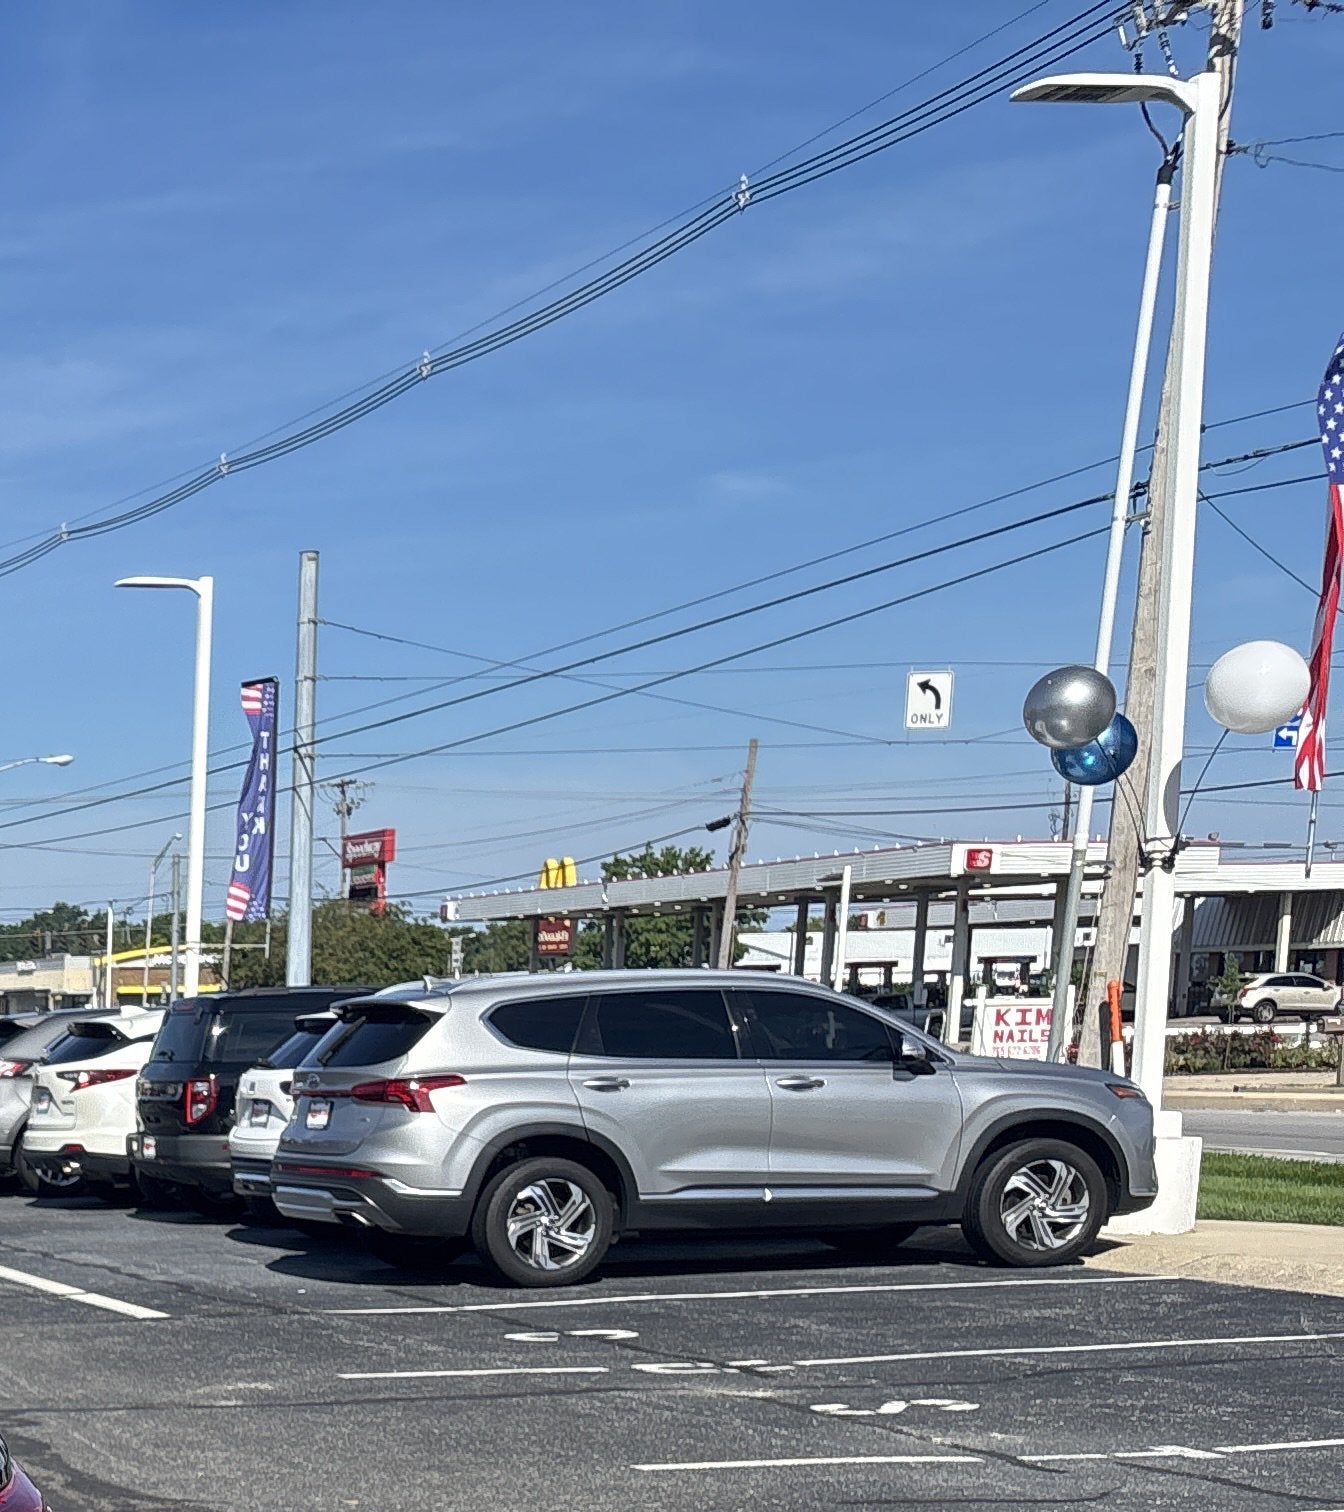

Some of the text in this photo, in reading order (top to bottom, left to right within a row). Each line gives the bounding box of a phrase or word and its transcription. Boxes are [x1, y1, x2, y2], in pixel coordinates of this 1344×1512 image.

[910, 713, 944, 725] ONLY
[994, 1007, 1054, 1027] KIM
[993, 1029, 1051, 1043] NAILS
